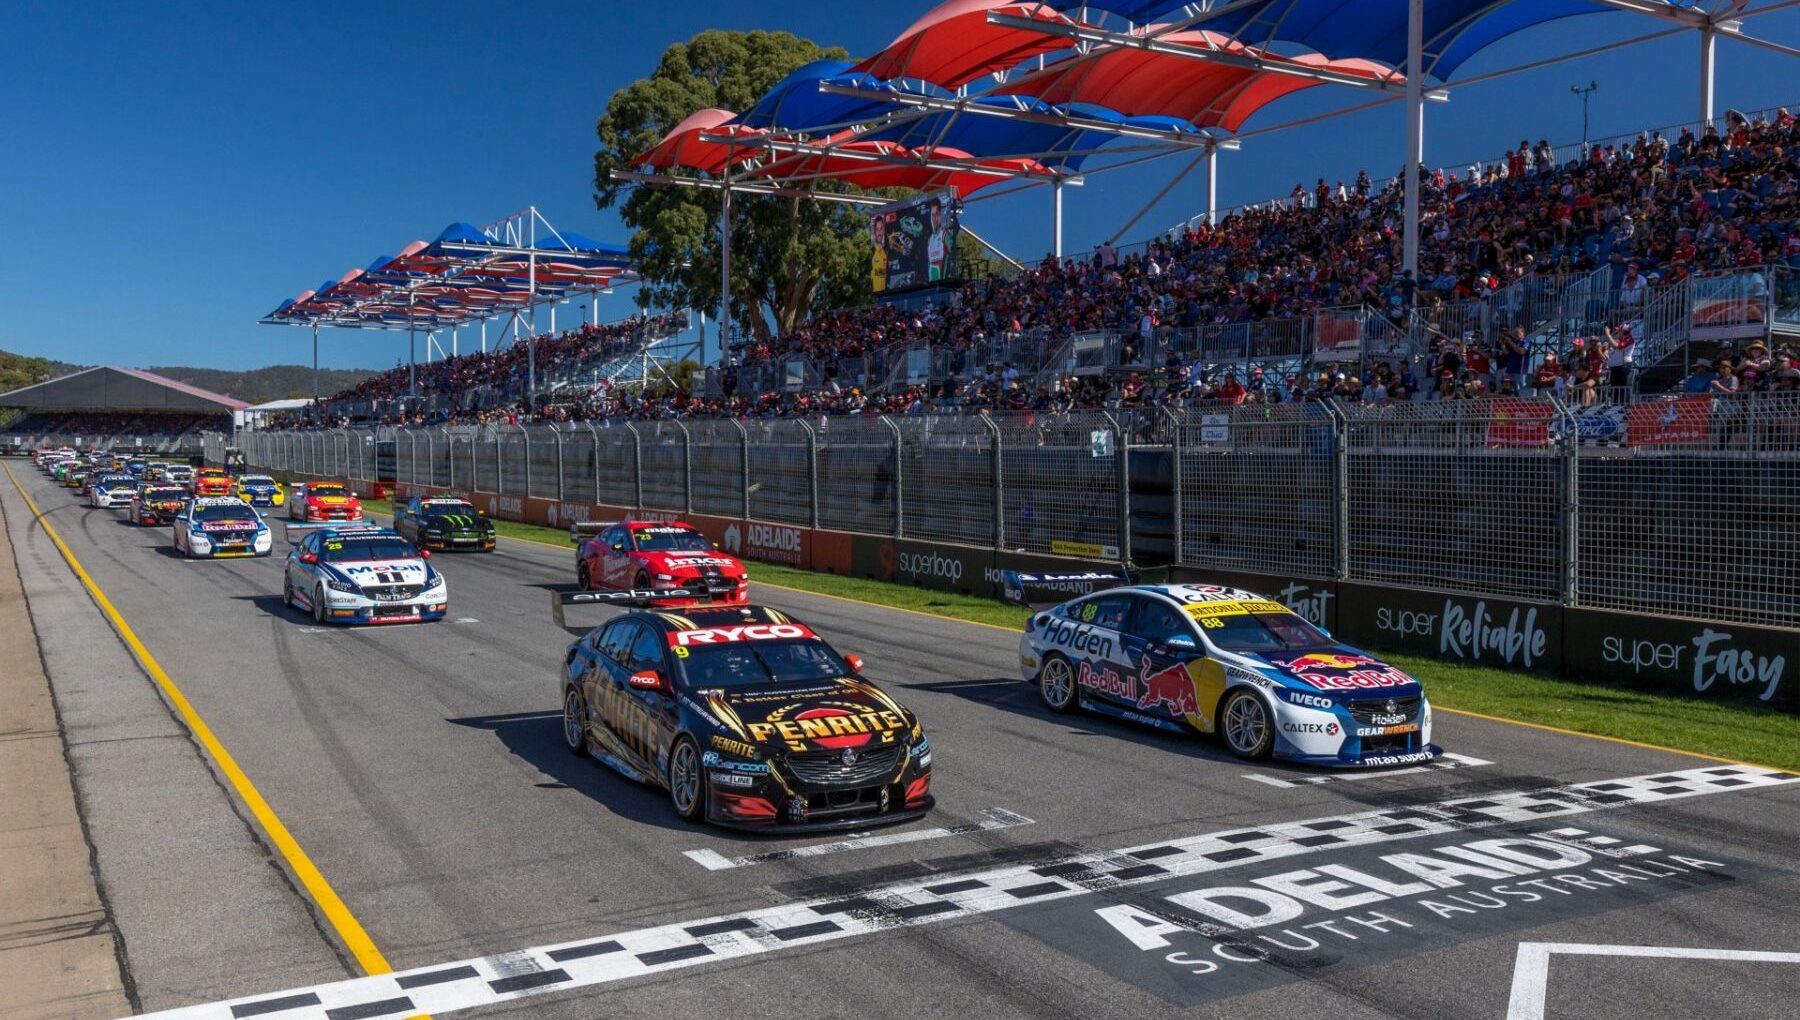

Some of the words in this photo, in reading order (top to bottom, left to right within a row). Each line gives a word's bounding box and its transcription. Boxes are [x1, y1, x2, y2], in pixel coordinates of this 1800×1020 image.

[748, 523, 801, 552] ADELAIDE
[346, 564, 422, 575] Mobil
[900, 551, 962, 584] superloop
[1082, 603, 1098, 620] 88
[1187, 604, 1244, 617] NATIONAL
[1201, 618, 1225, 629] 88
[1376, 607, 1438, 639] super
[1440, 599, 1546, 668] Reliable
[677, 624, 804, 647] RYCO
[1043, 617, 1113, 658] Holden
[675, 645, 691, 659] 9
[1603, 636, 1687, 673] super
[1692, 627, 1785, 701] Easy
[630, 675, 655, 684] RYCO
[1227, 666, 1272, 689] GEARWRENCH
[1290, 692, 1332, 709] IVECO
[748, 710, 903, 742] PENRITE
[1283, 722, 1323, 734] CALTEX
[1372, 713, 1407, 725] Holden
[711, 735, 756, 759] PENRITE
[1365, 755, 1398, 766] mtaa
[733, 776, 751, 785] LINE
[1094, 827, 1663, 951] ADELAIDE
[1165, 911, 1413, 974] SOUTH
[1417, 855, 1726, 918] AUSTRALIA
